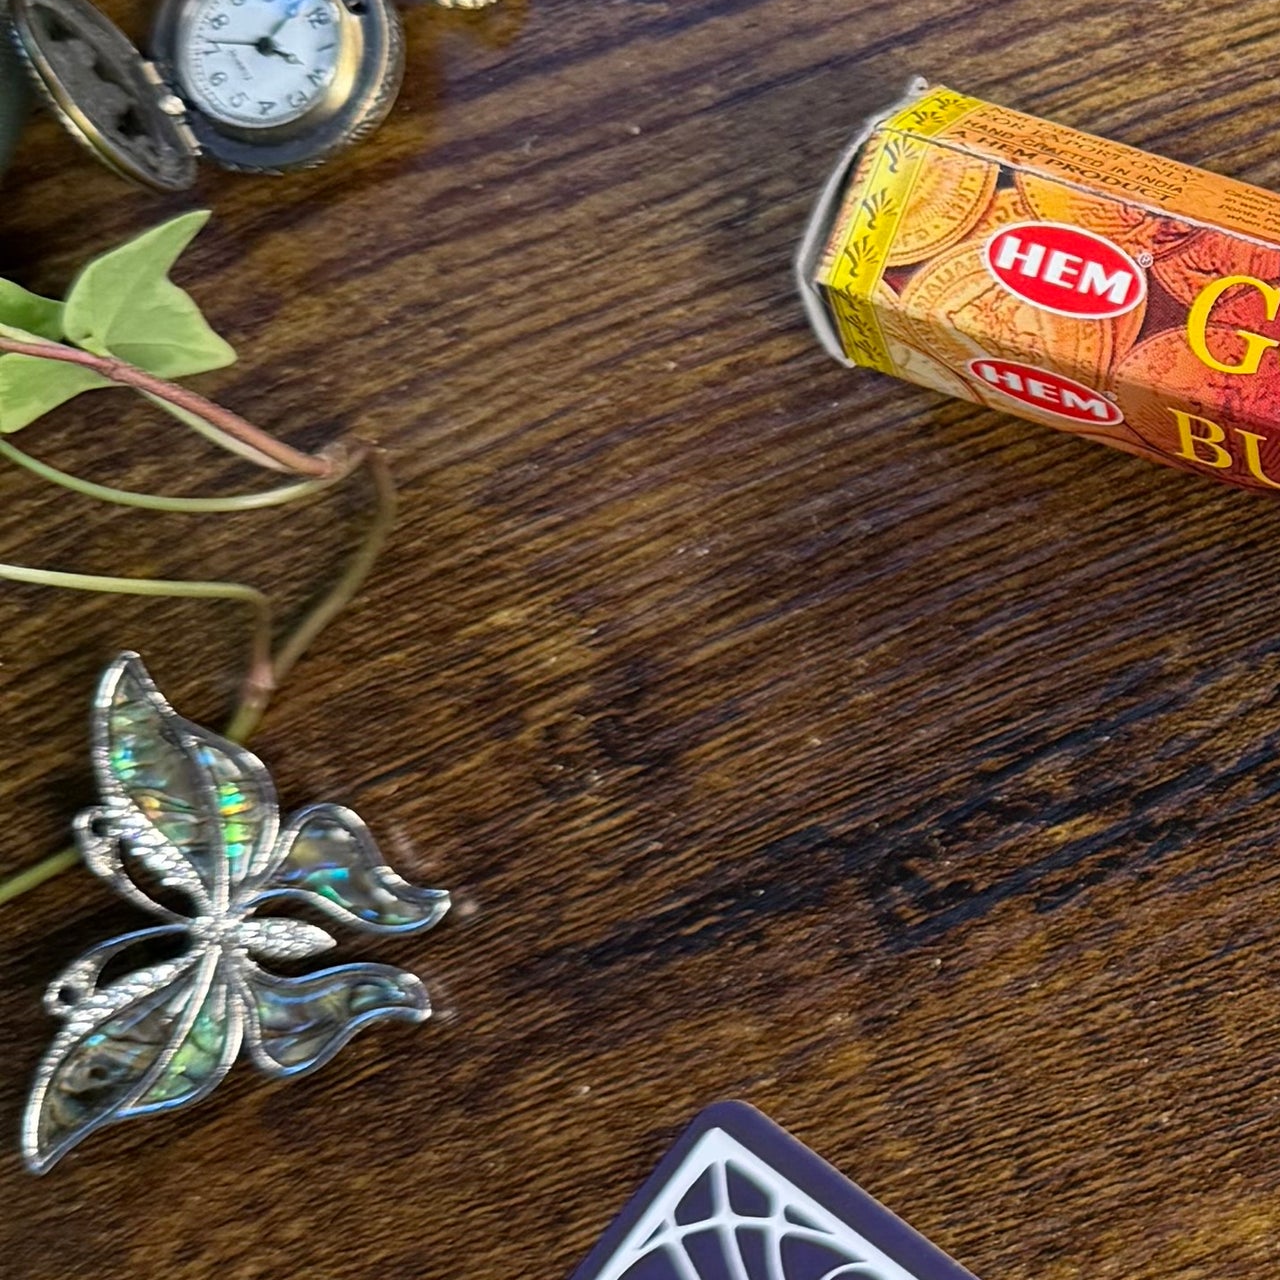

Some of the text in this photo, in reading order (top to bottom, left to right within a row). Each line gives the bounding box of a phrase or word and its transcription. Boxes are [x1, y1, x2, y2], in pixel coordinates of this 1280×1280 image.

[949, 128, 1177, 203] A HEM PRODUCT
[961, 118, 1186, 193] HAND CRAFTED IN INDIA
[975, 110, 1198, 185] FOR EXPORT ONLY
[995, 235, 1134, 306] HEM
[978, 363, 1110, 420] HEM
